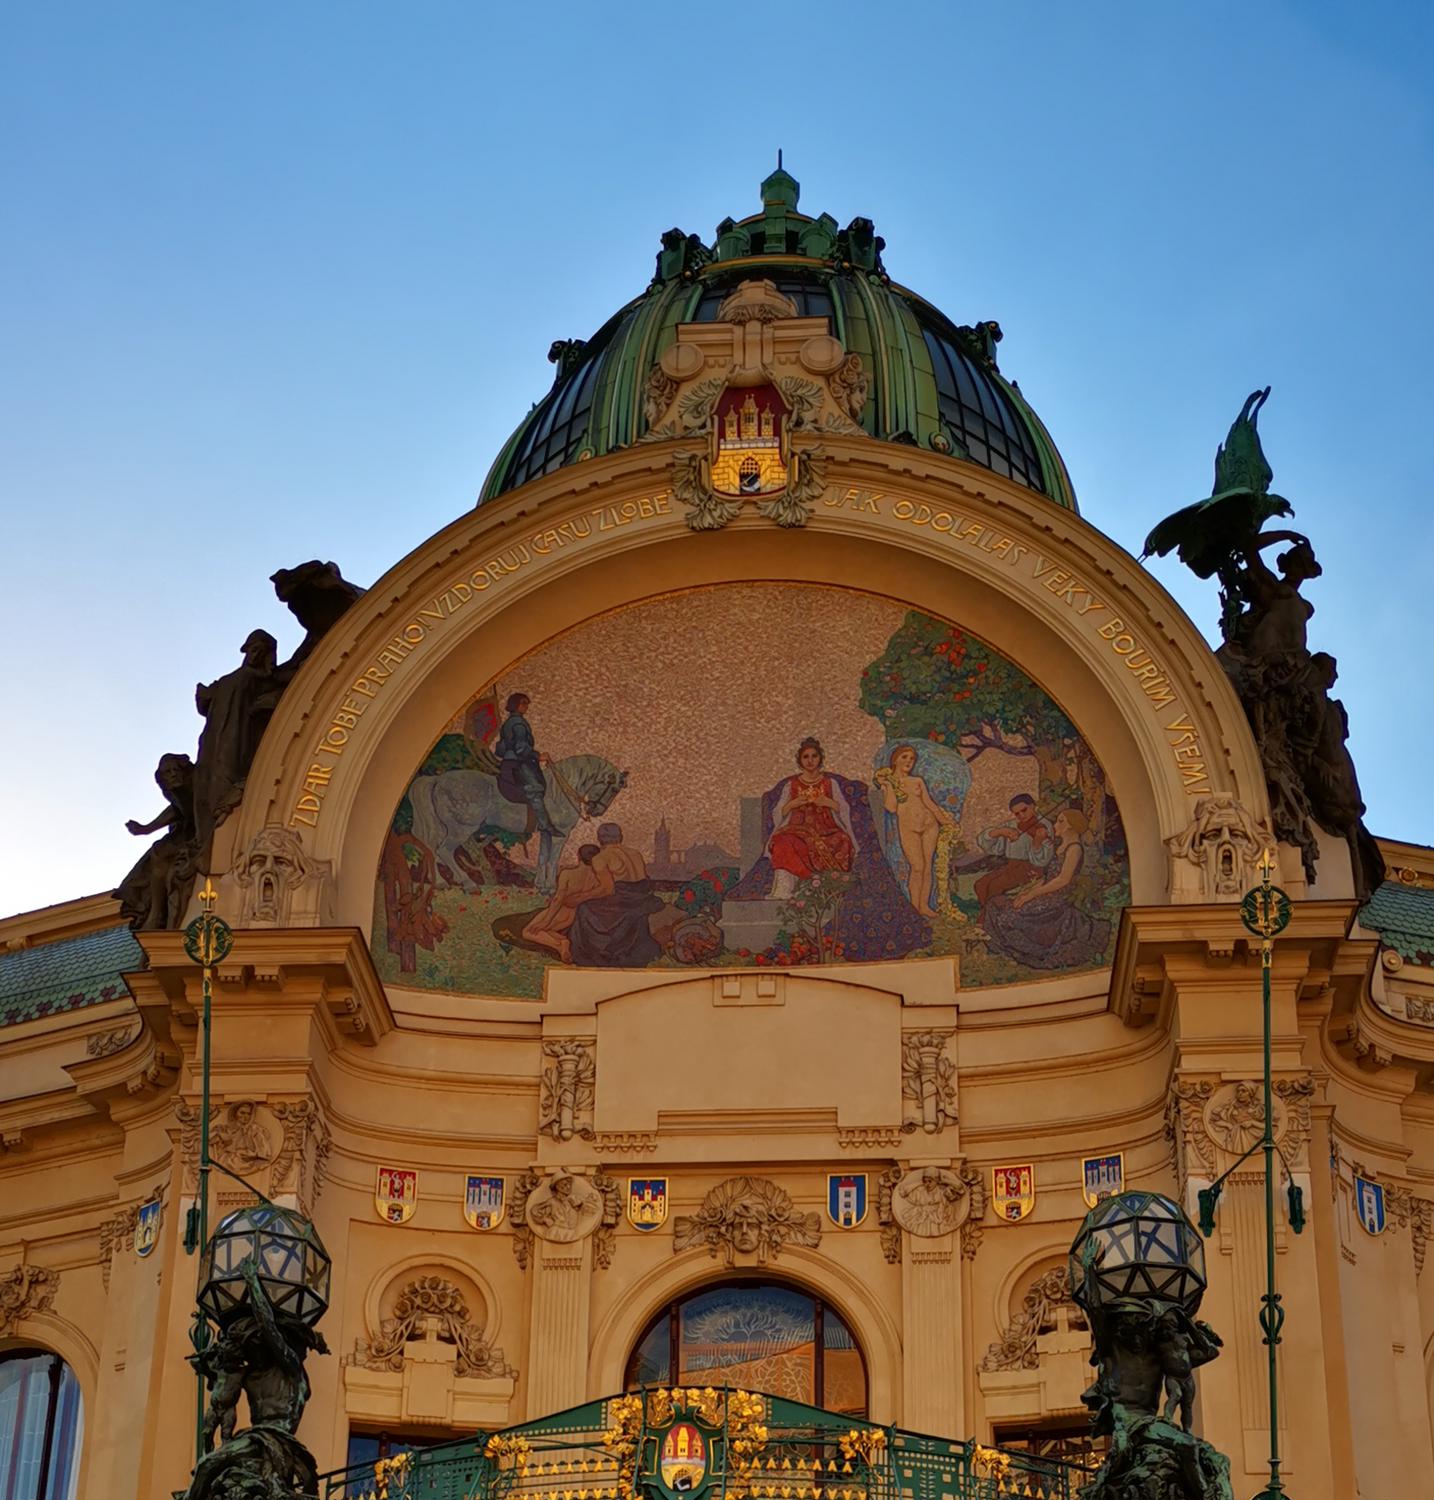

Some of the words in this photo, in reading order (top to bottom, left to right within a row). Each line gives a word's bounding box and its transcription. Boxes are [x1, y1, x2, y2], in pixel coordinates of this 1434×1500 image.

[824, 486, 885, 514] JAK
[892, 499, 1028, 566] ODOLALAS
[290, 762, 335, 828] ZDAR
[420, 544, 531, 619] VZDORUJ
